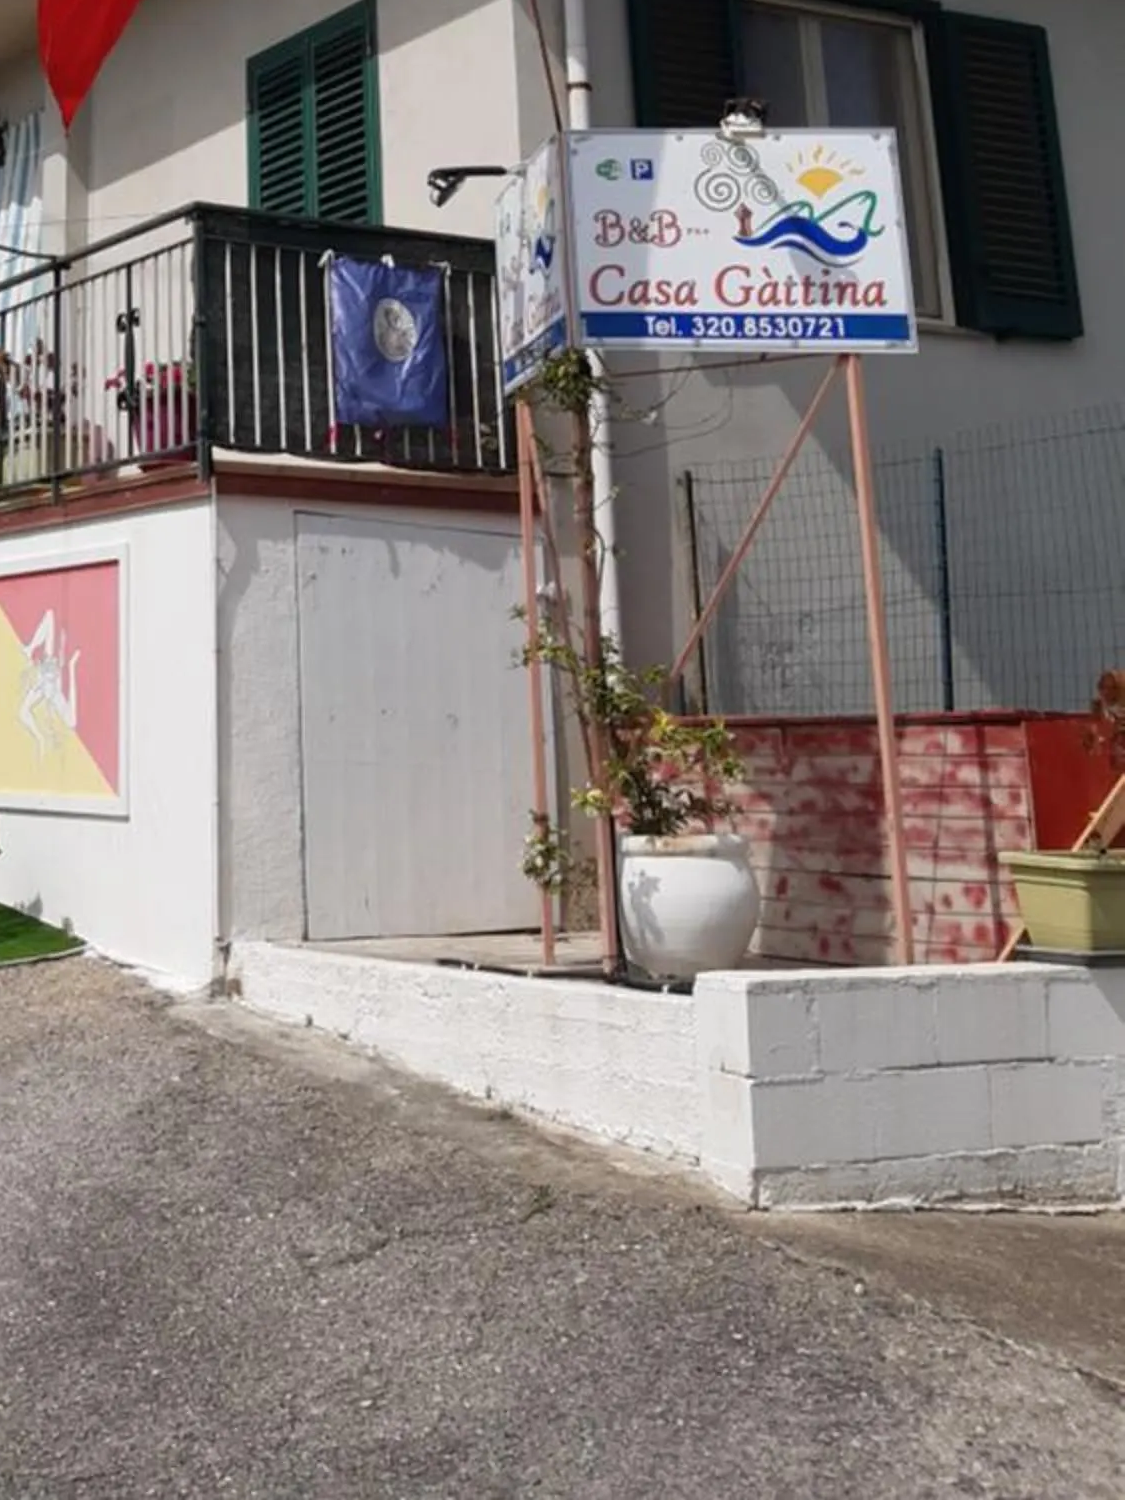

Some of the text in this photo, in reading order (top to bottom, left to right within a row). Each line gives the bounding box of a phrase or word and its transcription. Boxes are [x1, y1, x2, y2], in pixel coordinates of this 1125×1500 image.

[634, 160, 651, 180] P
[589, 264, 888, 308] Casa Gàttina
[644, 316, 846, 338] Tel. 320.8530721
